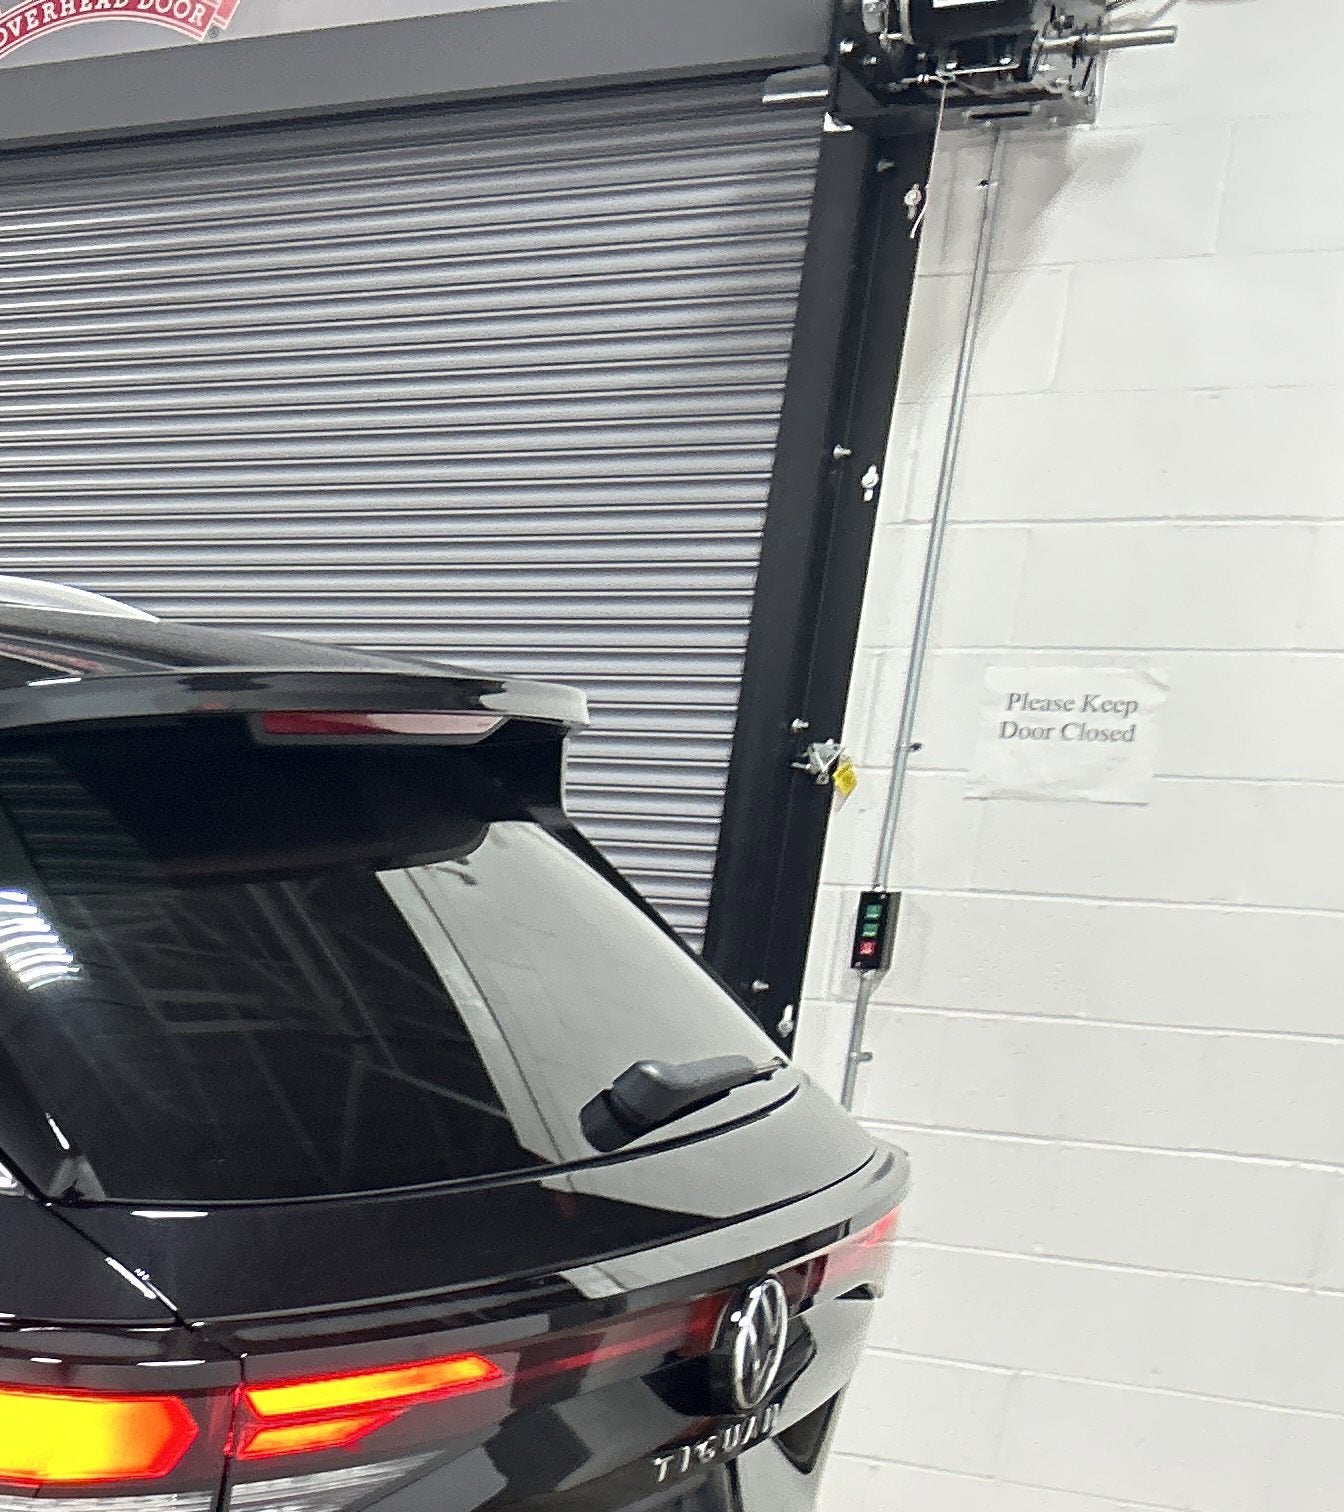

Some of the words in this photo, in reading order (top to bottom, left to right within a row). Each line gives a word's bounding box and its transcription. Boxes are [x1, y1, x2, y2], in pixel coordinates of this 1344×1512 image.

[137, 0, 206, 26] DOOR
[1005, 691, 1075, 712] Please
[1081, 693, 1139, 718] Keep
[999, 720, 1055, 741] Door
[1062, 721, 1136, 743] Closed
[653, 1403, 781, 1482] TIGUAN
